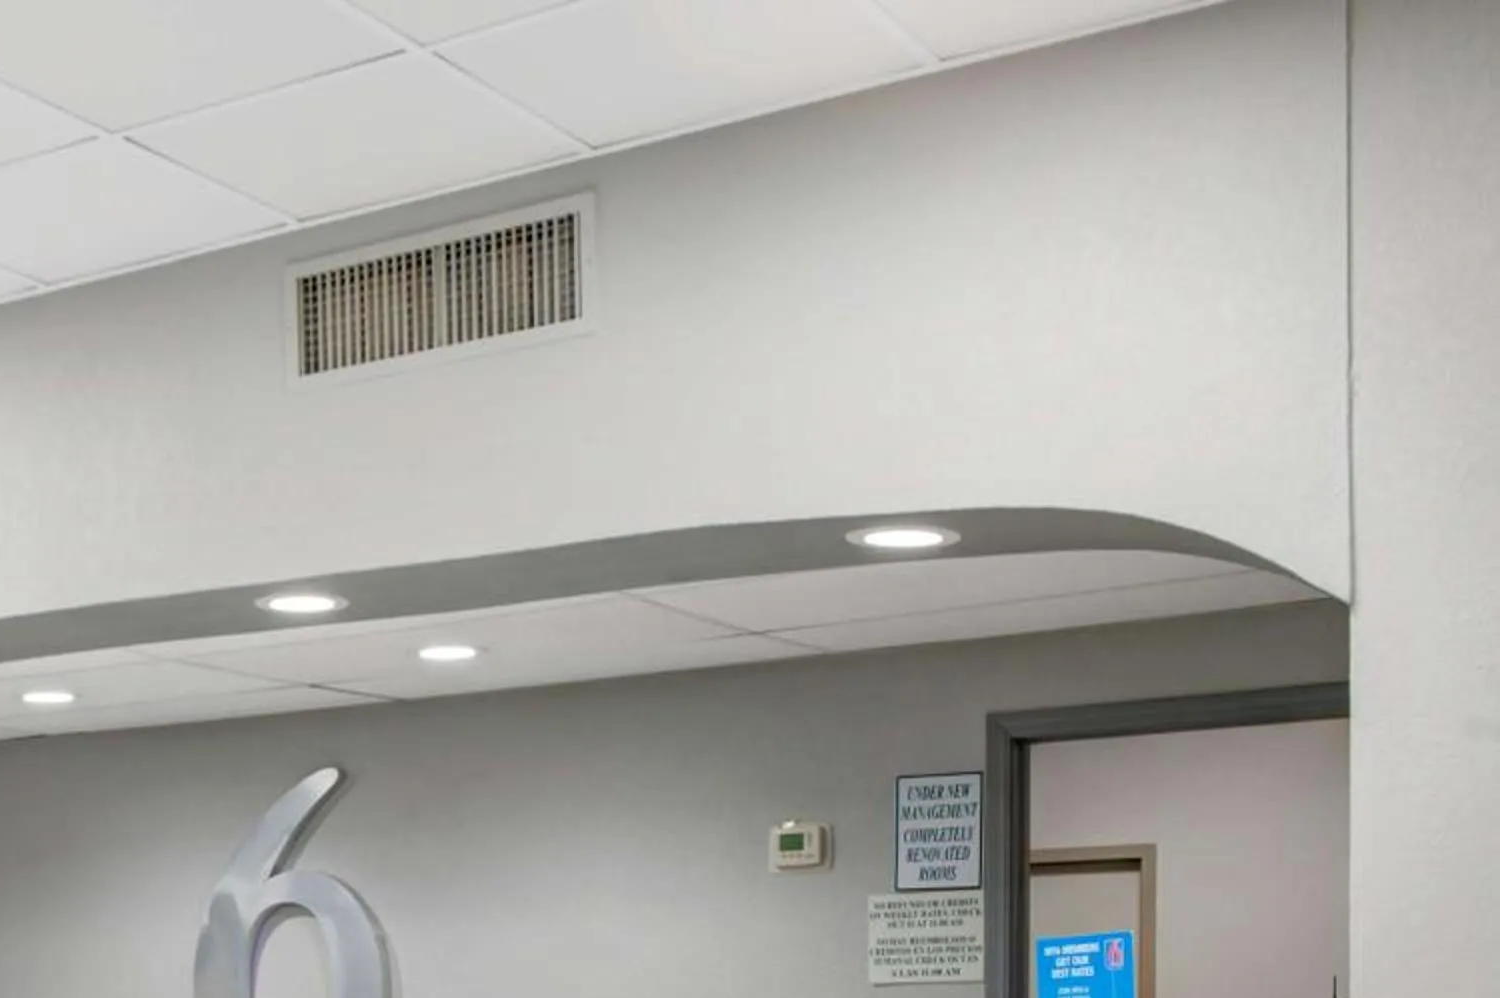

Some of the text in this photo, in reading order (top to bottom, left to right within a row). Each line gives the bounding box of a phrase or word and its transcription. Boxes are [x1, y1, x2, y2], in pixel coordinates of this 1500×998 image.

[907, 783, 970, 800] UNDER NEW
[901, 802, 977, 820] MANAGEMENT
[903, 826, 973, 842] COMPLETELY
[906, 846, 971, 862] RENOVATED
[919, 866, 957, 880] ROOMS
